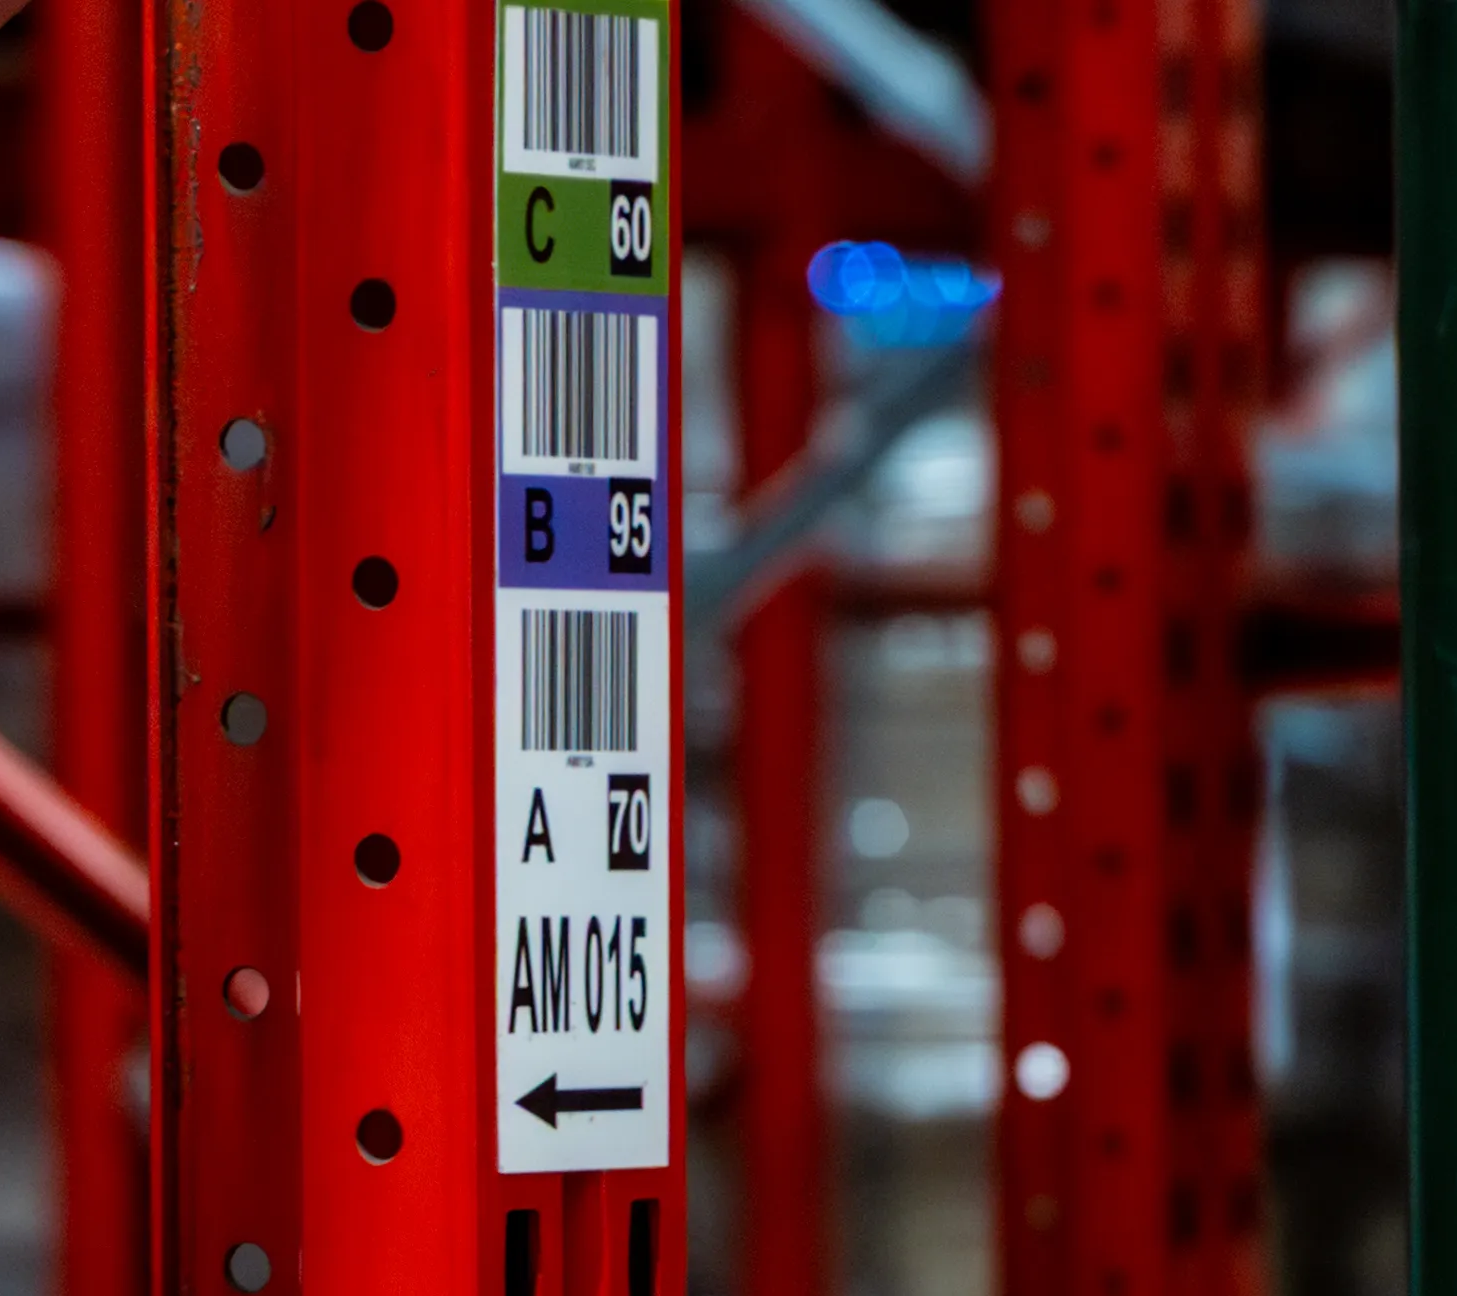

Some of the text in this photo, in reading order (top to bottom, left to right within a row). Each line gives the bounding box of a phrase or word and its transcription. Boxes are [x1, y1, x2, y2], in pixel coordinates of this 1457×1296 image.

[526, 186, 651, 263] C 60
[525, 488, 651, 562] B 95
[521, 787, 650, 862] A 70
[508, 915, 647, 1033] AM 015
